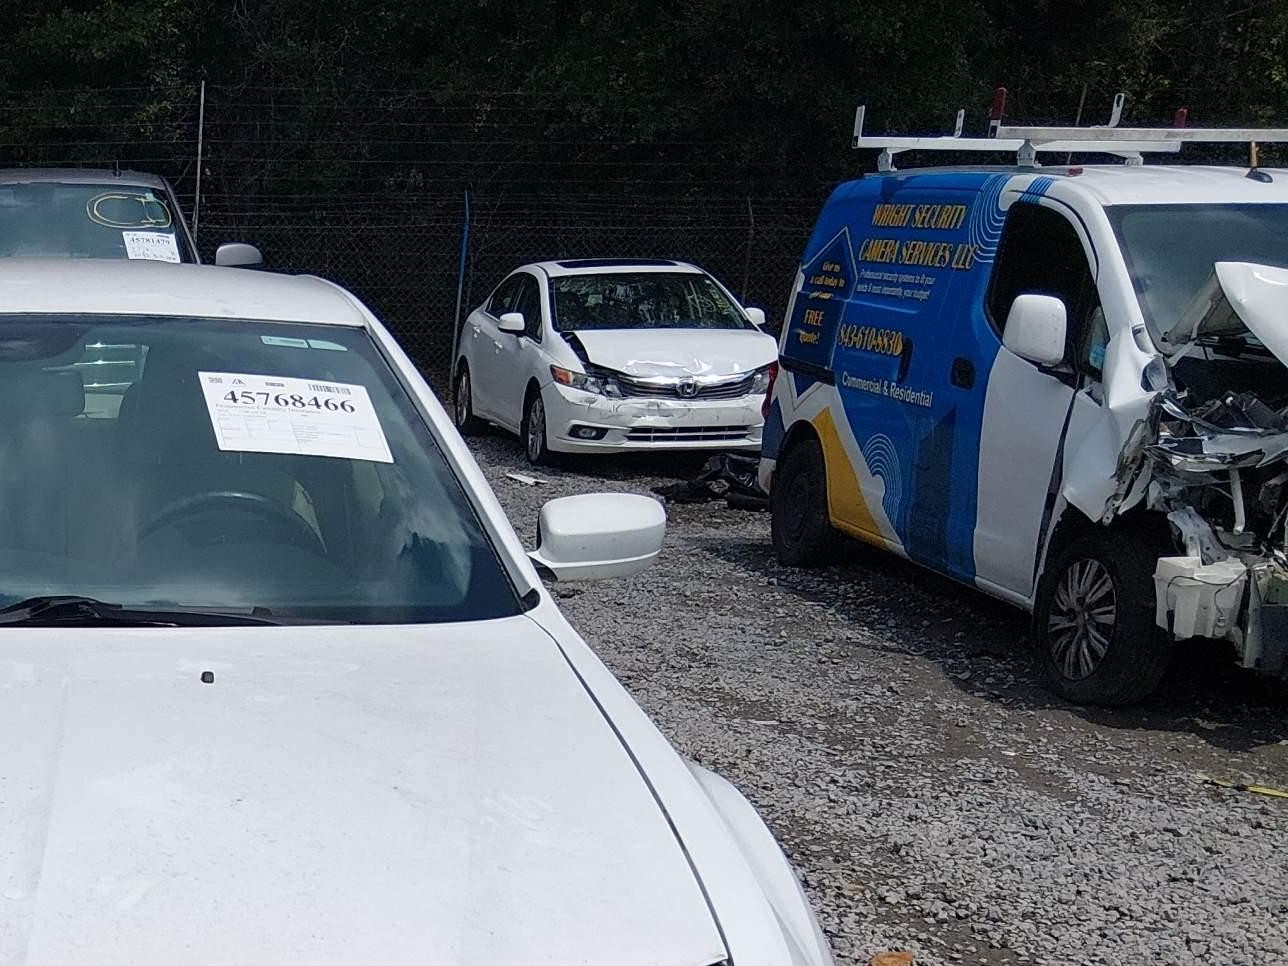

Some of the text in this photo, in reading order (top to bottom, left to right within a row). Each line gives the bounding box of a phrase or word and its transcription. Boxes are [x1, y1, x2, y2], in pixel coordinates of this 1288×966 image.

[872, 204, 966, 229] WRIGHT SECURITY
[859, 239, 979, 269] CAMERA SERVICES LLC
[804, 309, 824, 326] FREE
[223, 390, 355, 414] 45768466
[842, 371, 934, 408] Commercial & Residential
